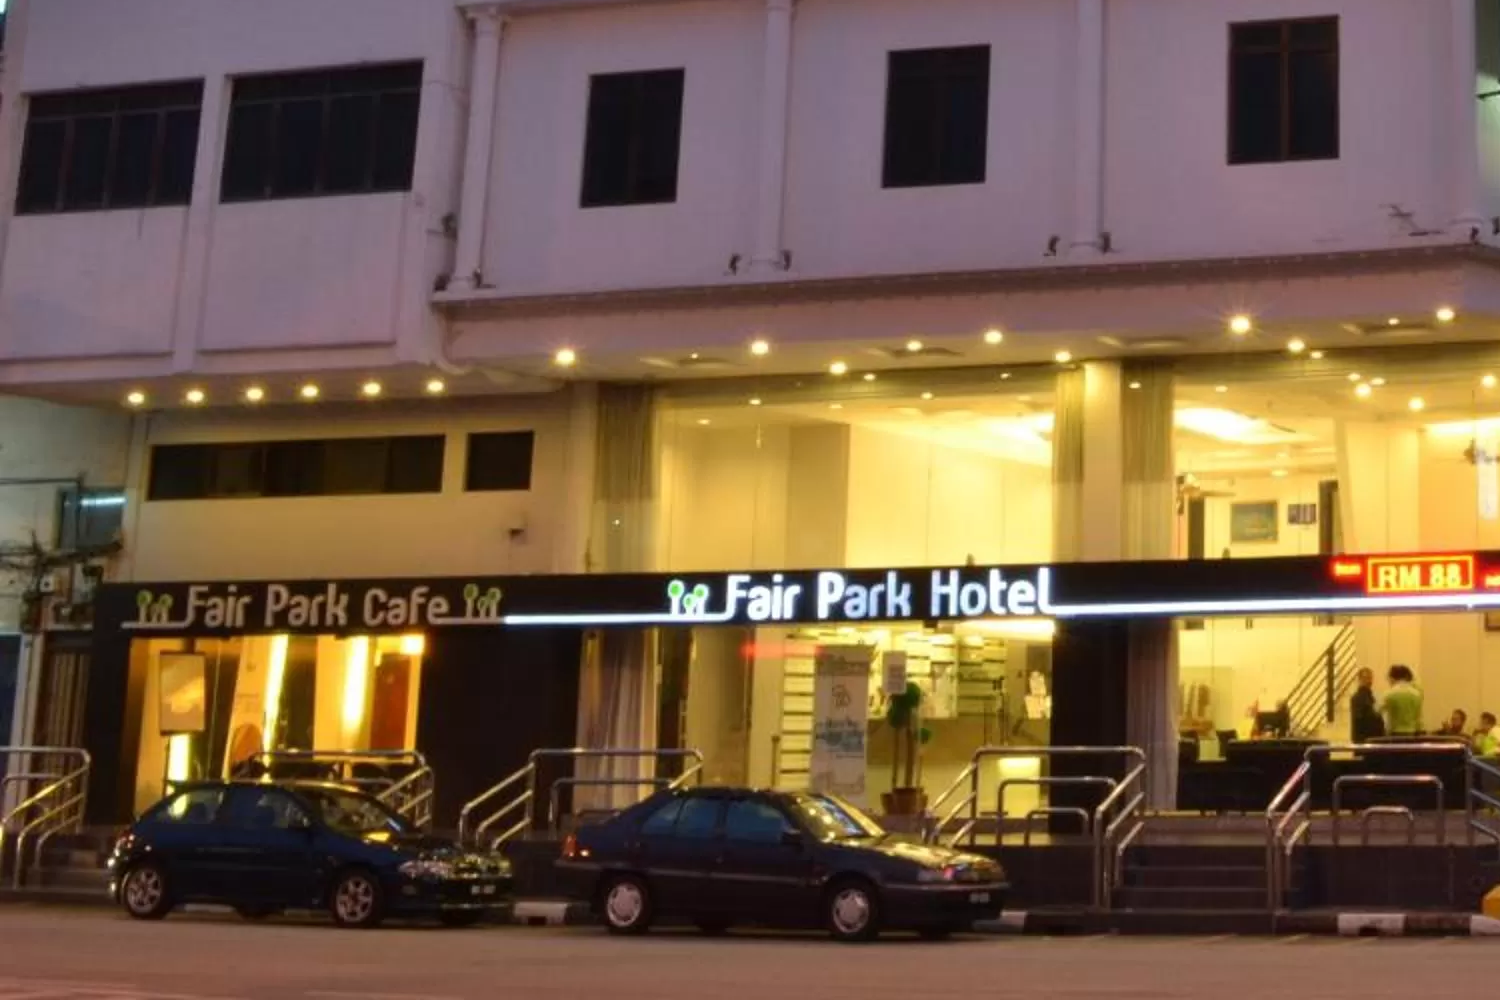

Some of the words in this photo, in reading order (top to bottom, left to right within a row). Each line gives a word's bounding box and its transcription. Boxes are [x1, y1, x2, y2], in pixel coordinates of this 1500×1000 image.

[720, 574, 803, 622] Fair
[816, 570, 913, 619] Park
[929, 566, 1052, 617] Hotel
[1377, 564, 1421, 589] RM
[1428, 562, 1462, 588] 88
[184, 585, 251, 628] Fair
[264, 583, 349, 627] Park
[363, 585, 450, 626] Cafe
